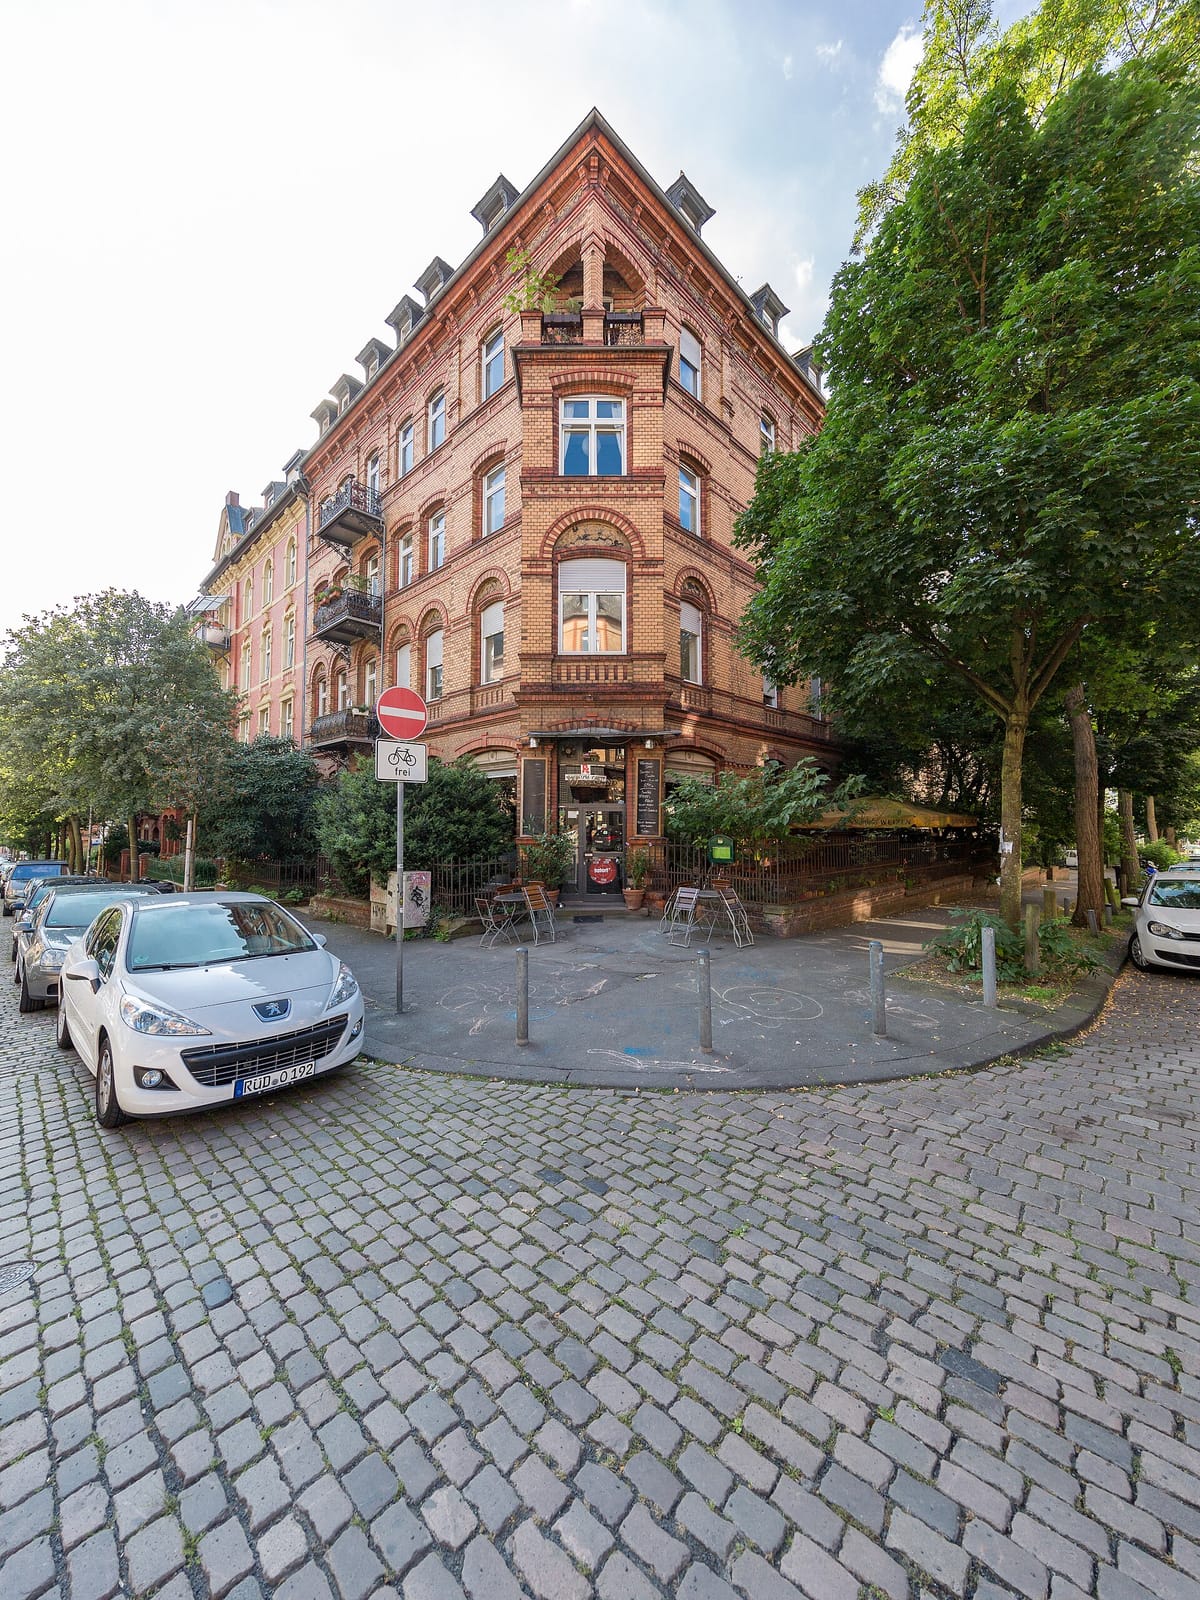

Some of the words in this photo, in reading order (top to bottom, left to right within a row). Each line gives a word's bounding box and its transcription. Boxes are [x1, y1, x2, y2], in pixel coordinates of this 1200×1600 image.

[395, 767, 411, 776] frei
[244, 1075, 271, 1093] RÜD
[291, 1064, 313, 1080] 192
